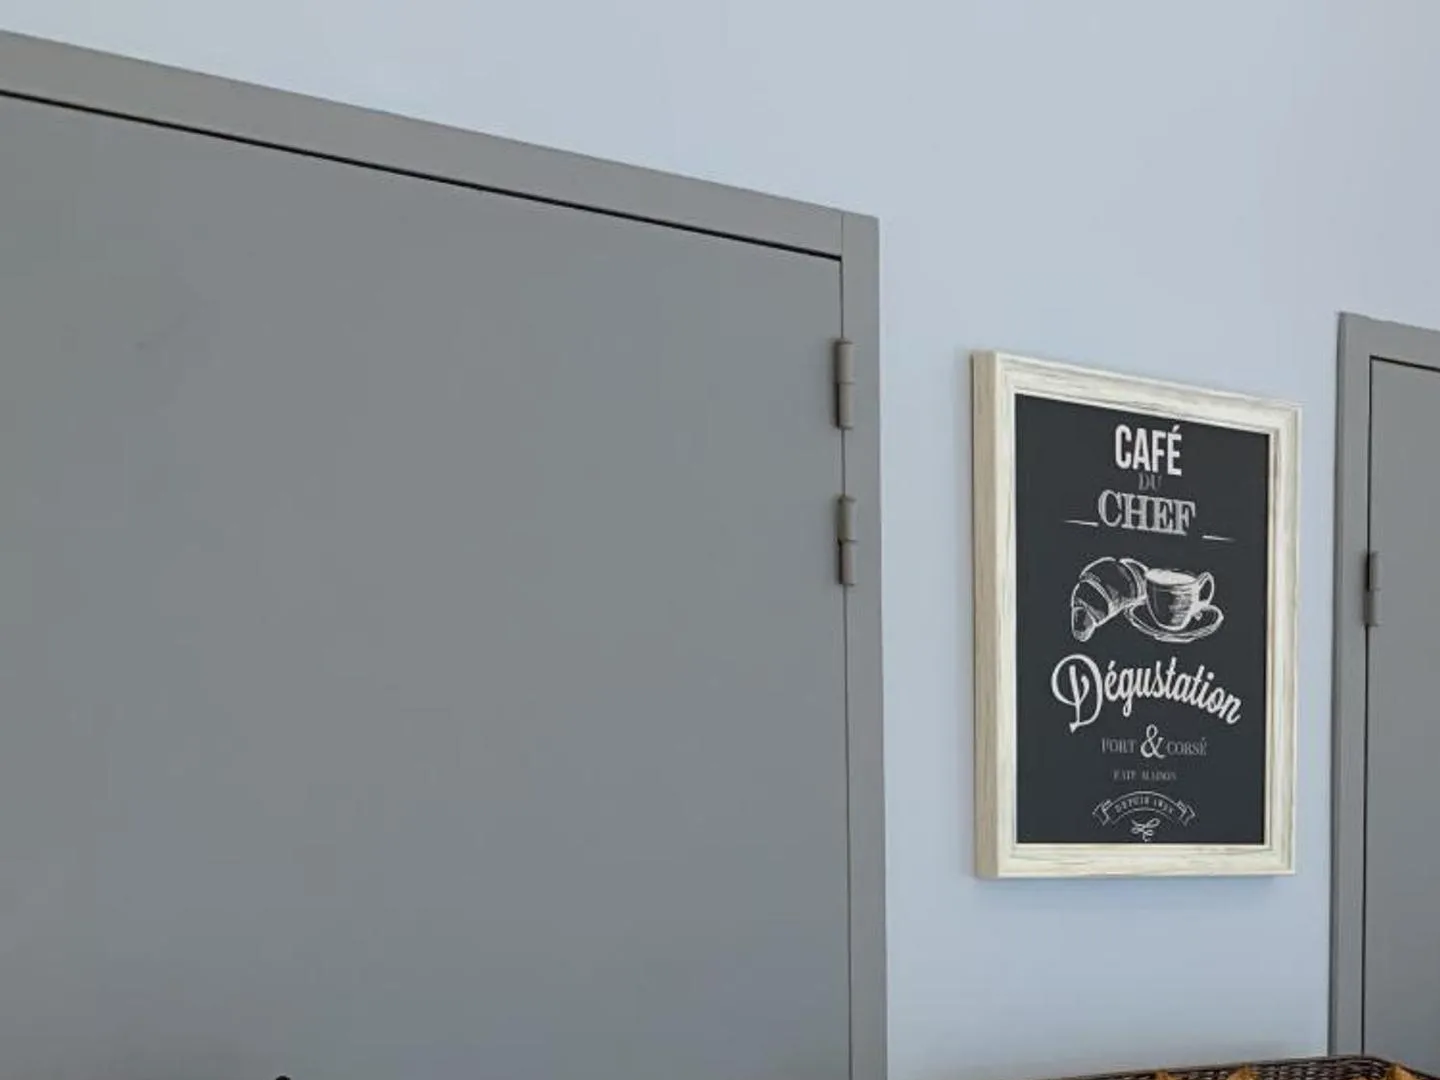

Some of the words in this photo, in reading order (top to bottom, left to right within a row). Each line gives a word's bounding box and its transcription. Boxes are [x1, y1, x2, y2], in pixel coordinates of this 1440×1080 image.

[1115, 424, 1182, 476] CAFÉ
[1098, 489, 1196, 536] CHEF
[1051, 654, 1242, 733] Dégustation
[1140, 724, 1166, 759] &
